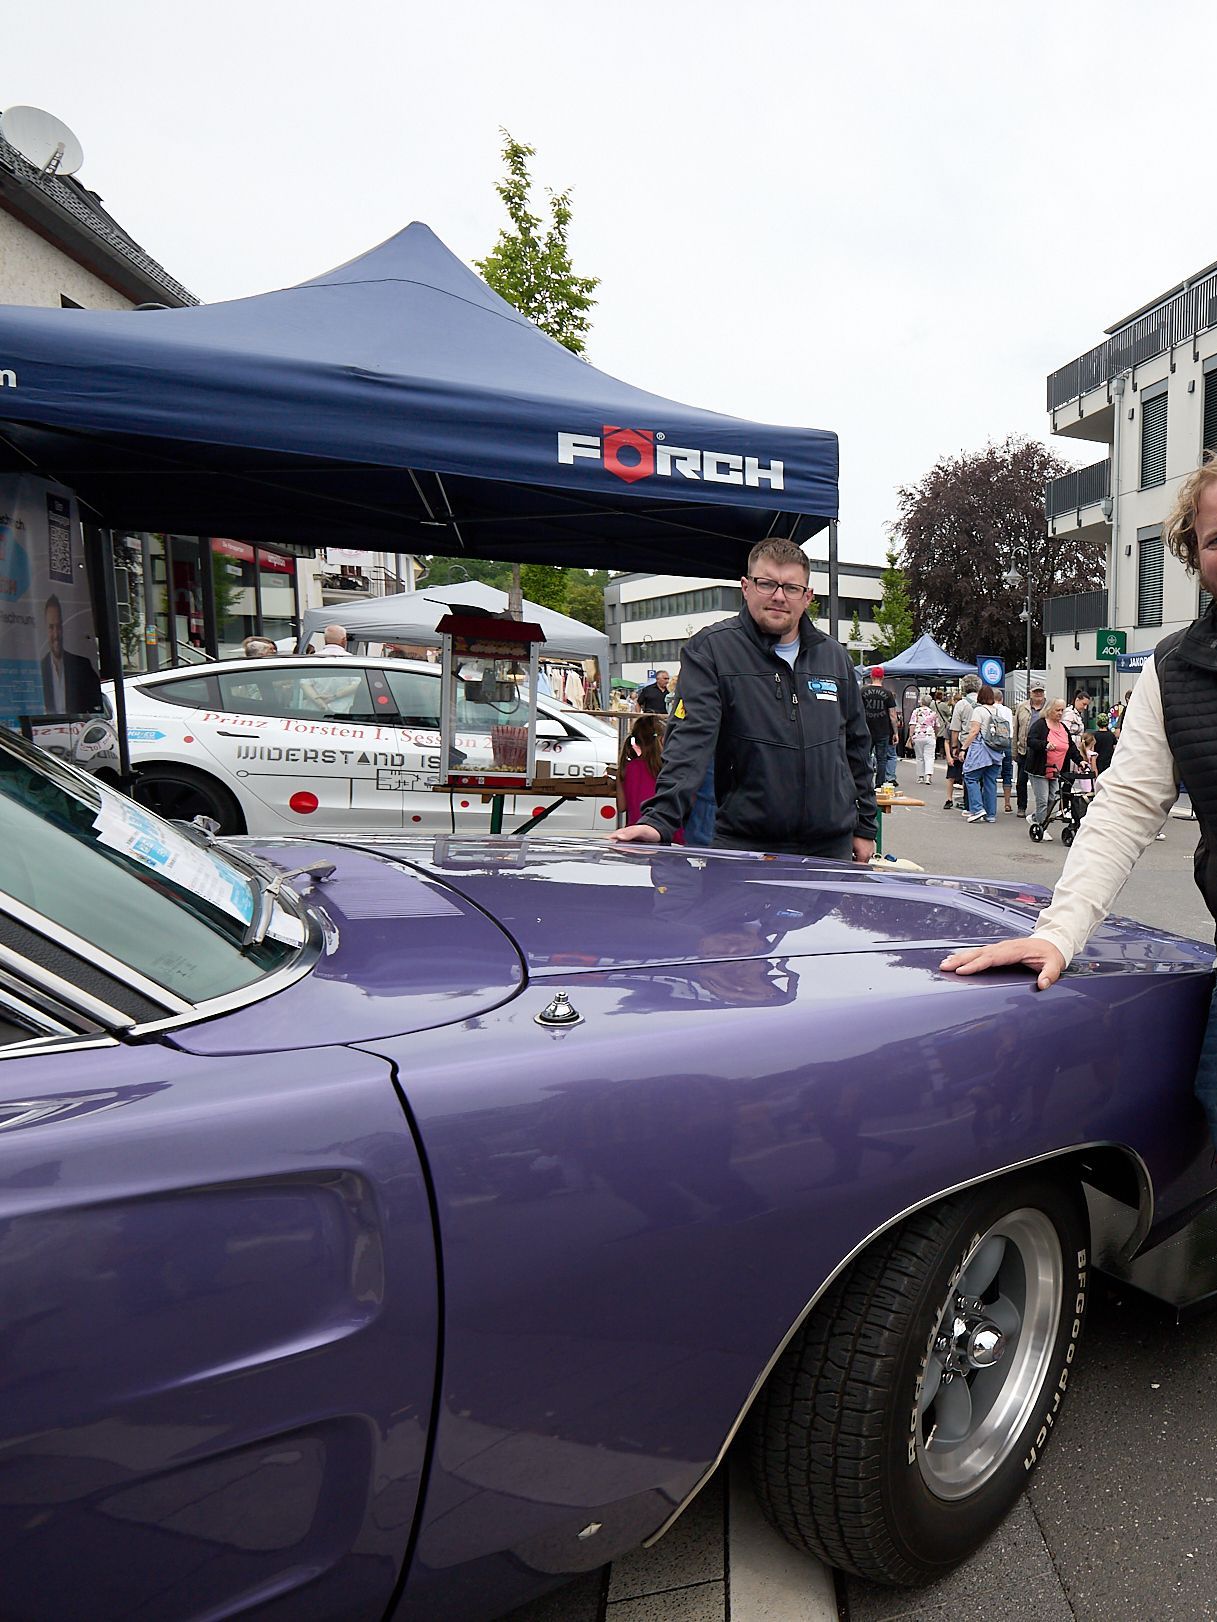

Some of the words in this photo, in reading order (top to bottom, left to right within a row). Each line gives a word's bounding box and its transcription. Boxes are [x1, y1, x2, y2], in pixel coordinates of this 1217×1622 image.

[1102, 646, 1121, 655] AOK
[203, 713, 268, 729] Prinz
[280, 719, 364, 738] Torsten
[400, 729, 476, 748] Sesson
[552, 763, 595, 777] LOS
